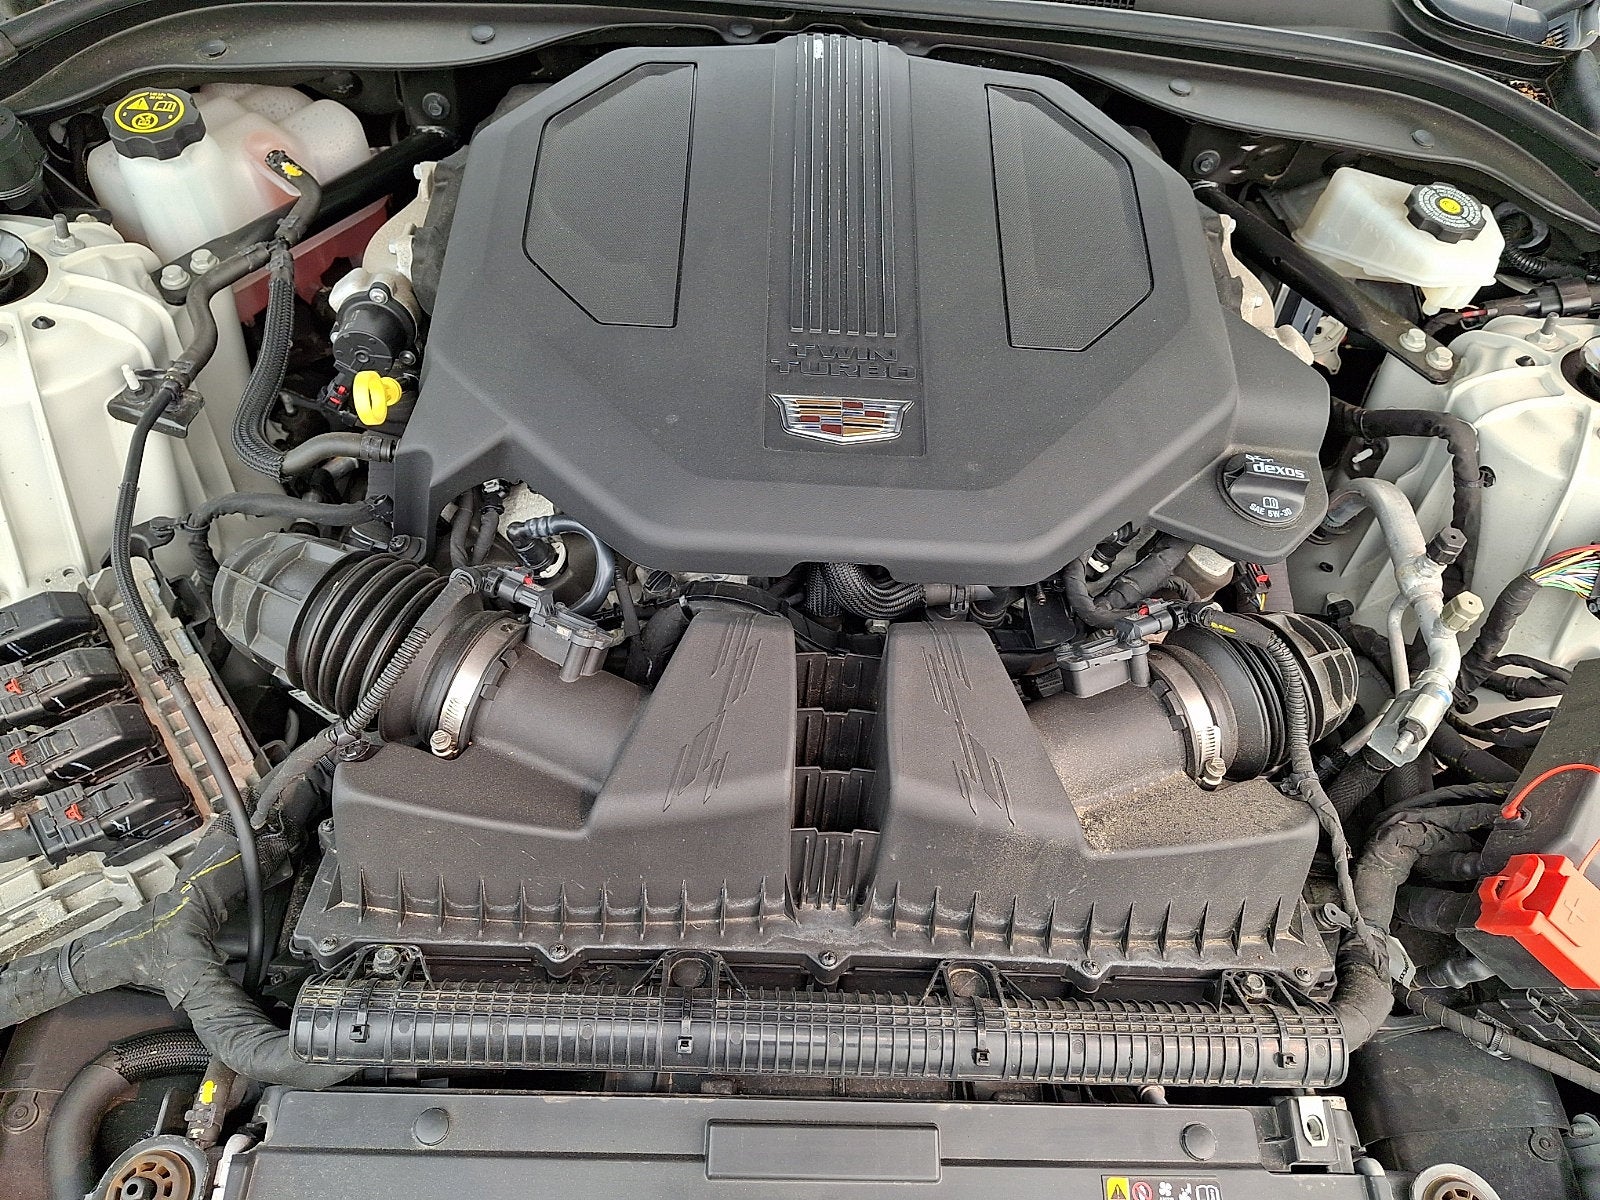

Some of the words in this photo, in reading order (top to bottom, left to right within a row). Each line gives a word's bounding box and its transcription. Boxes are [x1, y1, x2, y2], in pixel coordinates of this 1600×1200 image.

[787, 342, 898, 362] TWIN
[770, 358, 917, 381] TURBO
[1252, 462, 1305, 479] dexos
[1249, 503, 1266, 515] SAE
[1267, 508, 1292, 518] 5W-30
